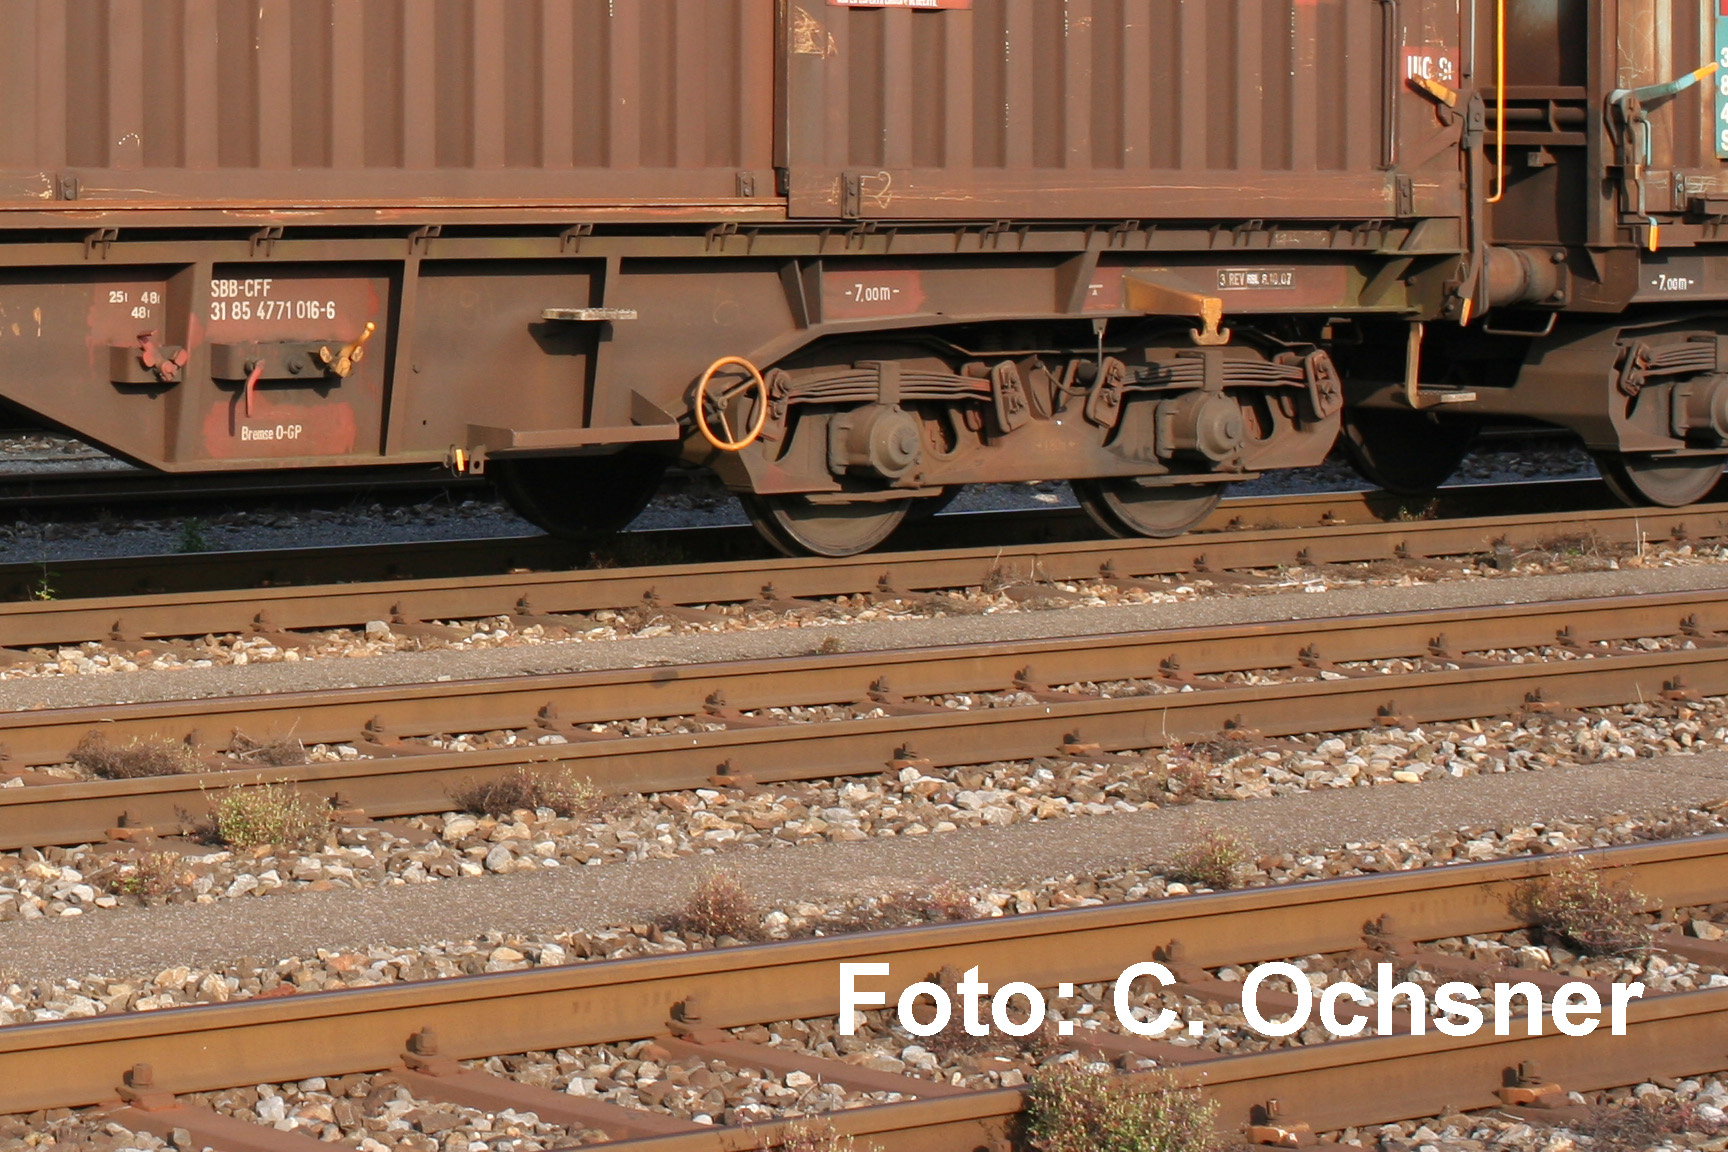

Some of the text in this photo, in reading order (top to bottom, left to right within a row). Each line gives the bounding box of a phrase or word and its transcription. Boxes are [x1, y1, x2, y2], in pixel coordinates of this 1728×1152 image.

[210, 279, 272, 298] SBB-CFF
[210, 300, 335, 321] 31 85 4771 016-6
